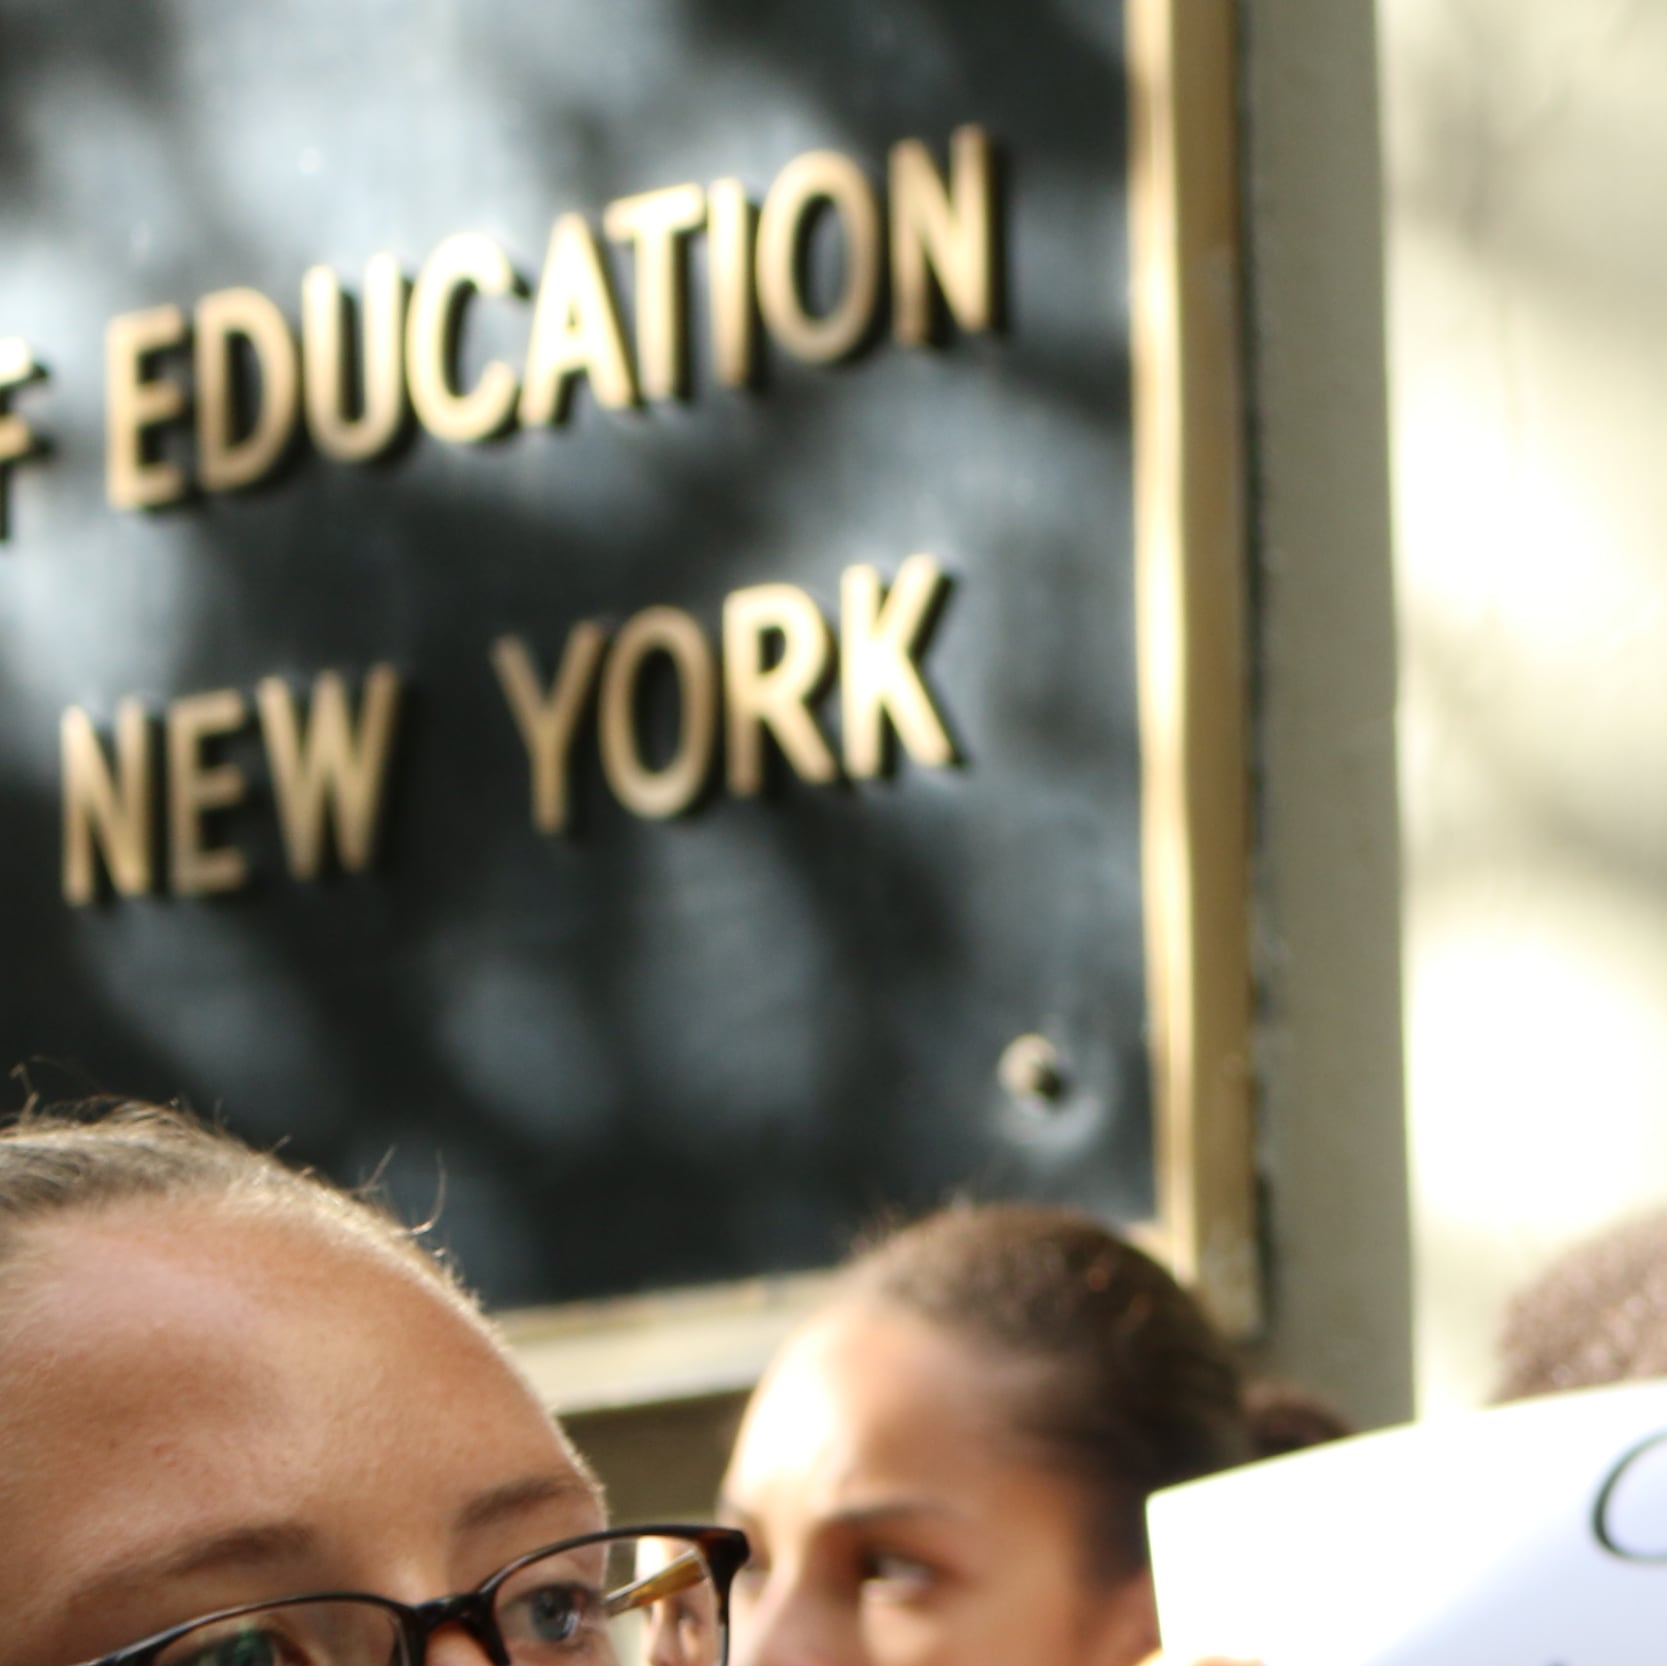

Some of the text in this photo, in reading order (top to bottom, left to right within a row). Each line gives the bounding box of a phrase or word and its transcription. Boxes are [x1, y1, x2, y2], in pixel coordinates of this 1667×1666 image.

[106, 126, 995, 510] EDUCATION
[60, 553, 957, 906] NEW YORK
